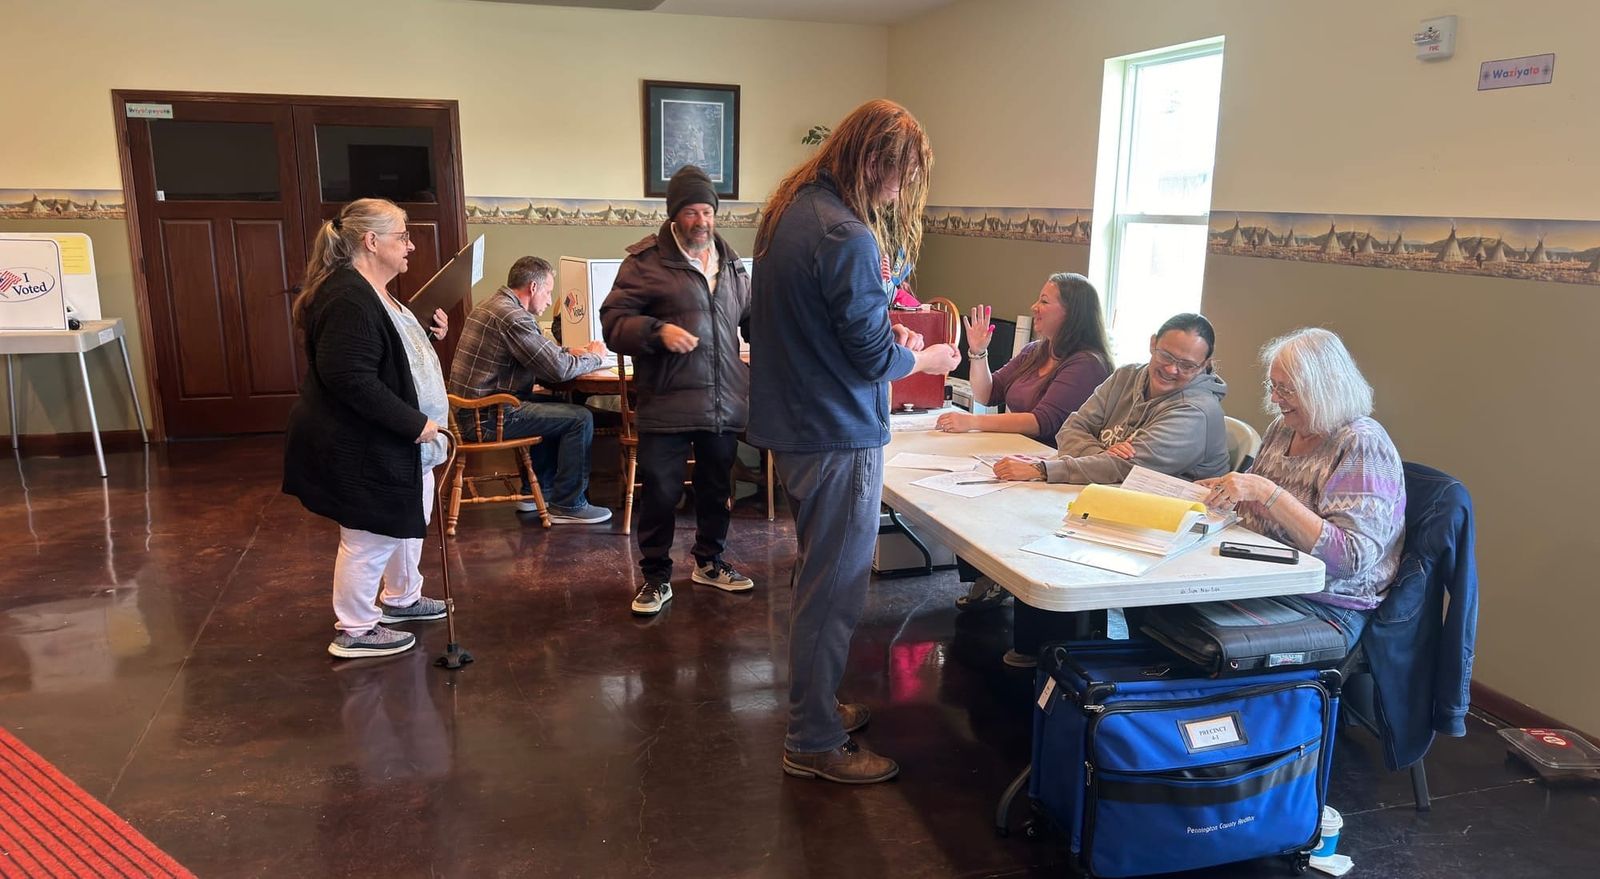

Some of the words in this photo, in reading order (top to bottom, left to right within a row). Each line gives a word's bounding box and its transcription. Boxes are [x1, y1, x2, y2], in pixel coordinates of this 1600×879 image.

[23, 272, 30, 283] I
[12, 282, 47, 296] Voted
[1199, 726, 1227, 736] PRECINCT
[1186, 824, 1218, 834] Pennington
[1219, 821, 1237, 831] County
